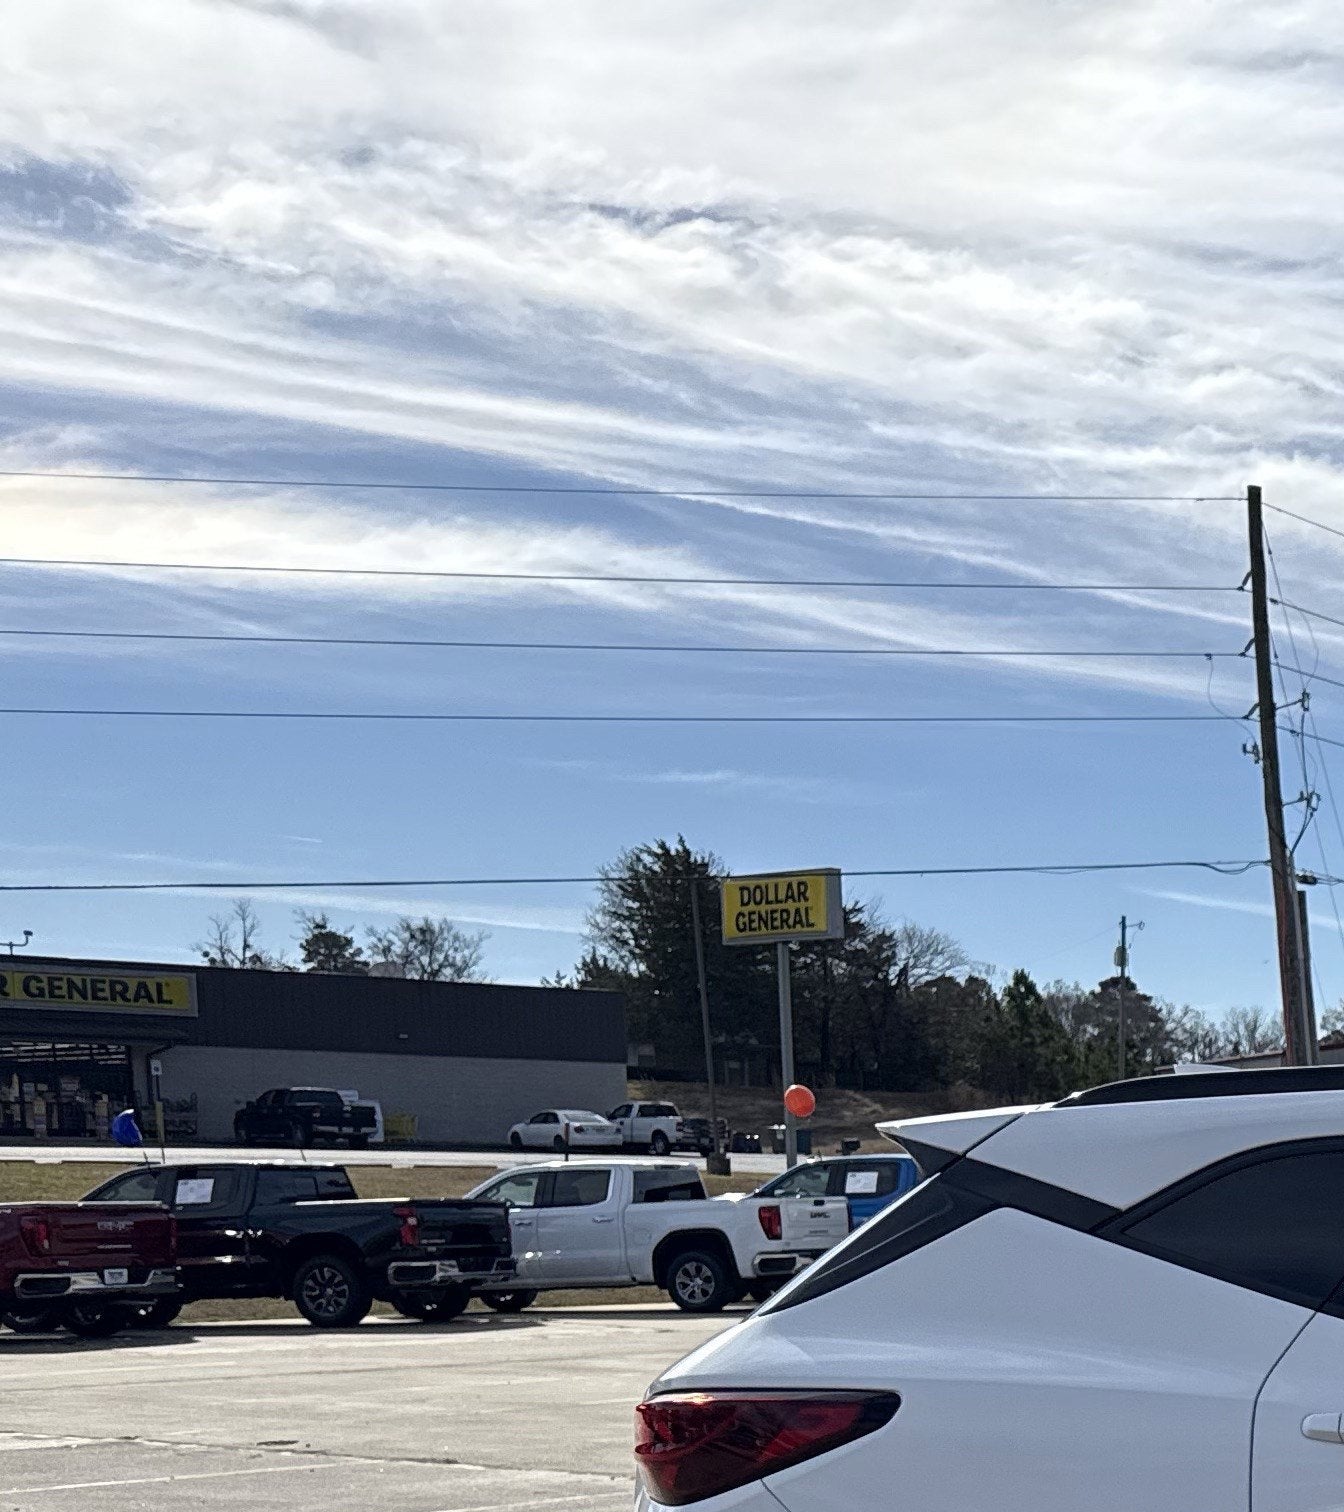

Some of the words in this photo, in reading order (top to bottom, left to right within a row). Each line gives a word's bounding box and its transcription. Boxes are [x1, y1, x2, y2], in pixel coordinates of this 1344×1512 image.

[739, 880, 810, 907] DOLLAR
[735, 907, 816, 933] GENERAL
[22, 975, 173, 1005] GENERAL
